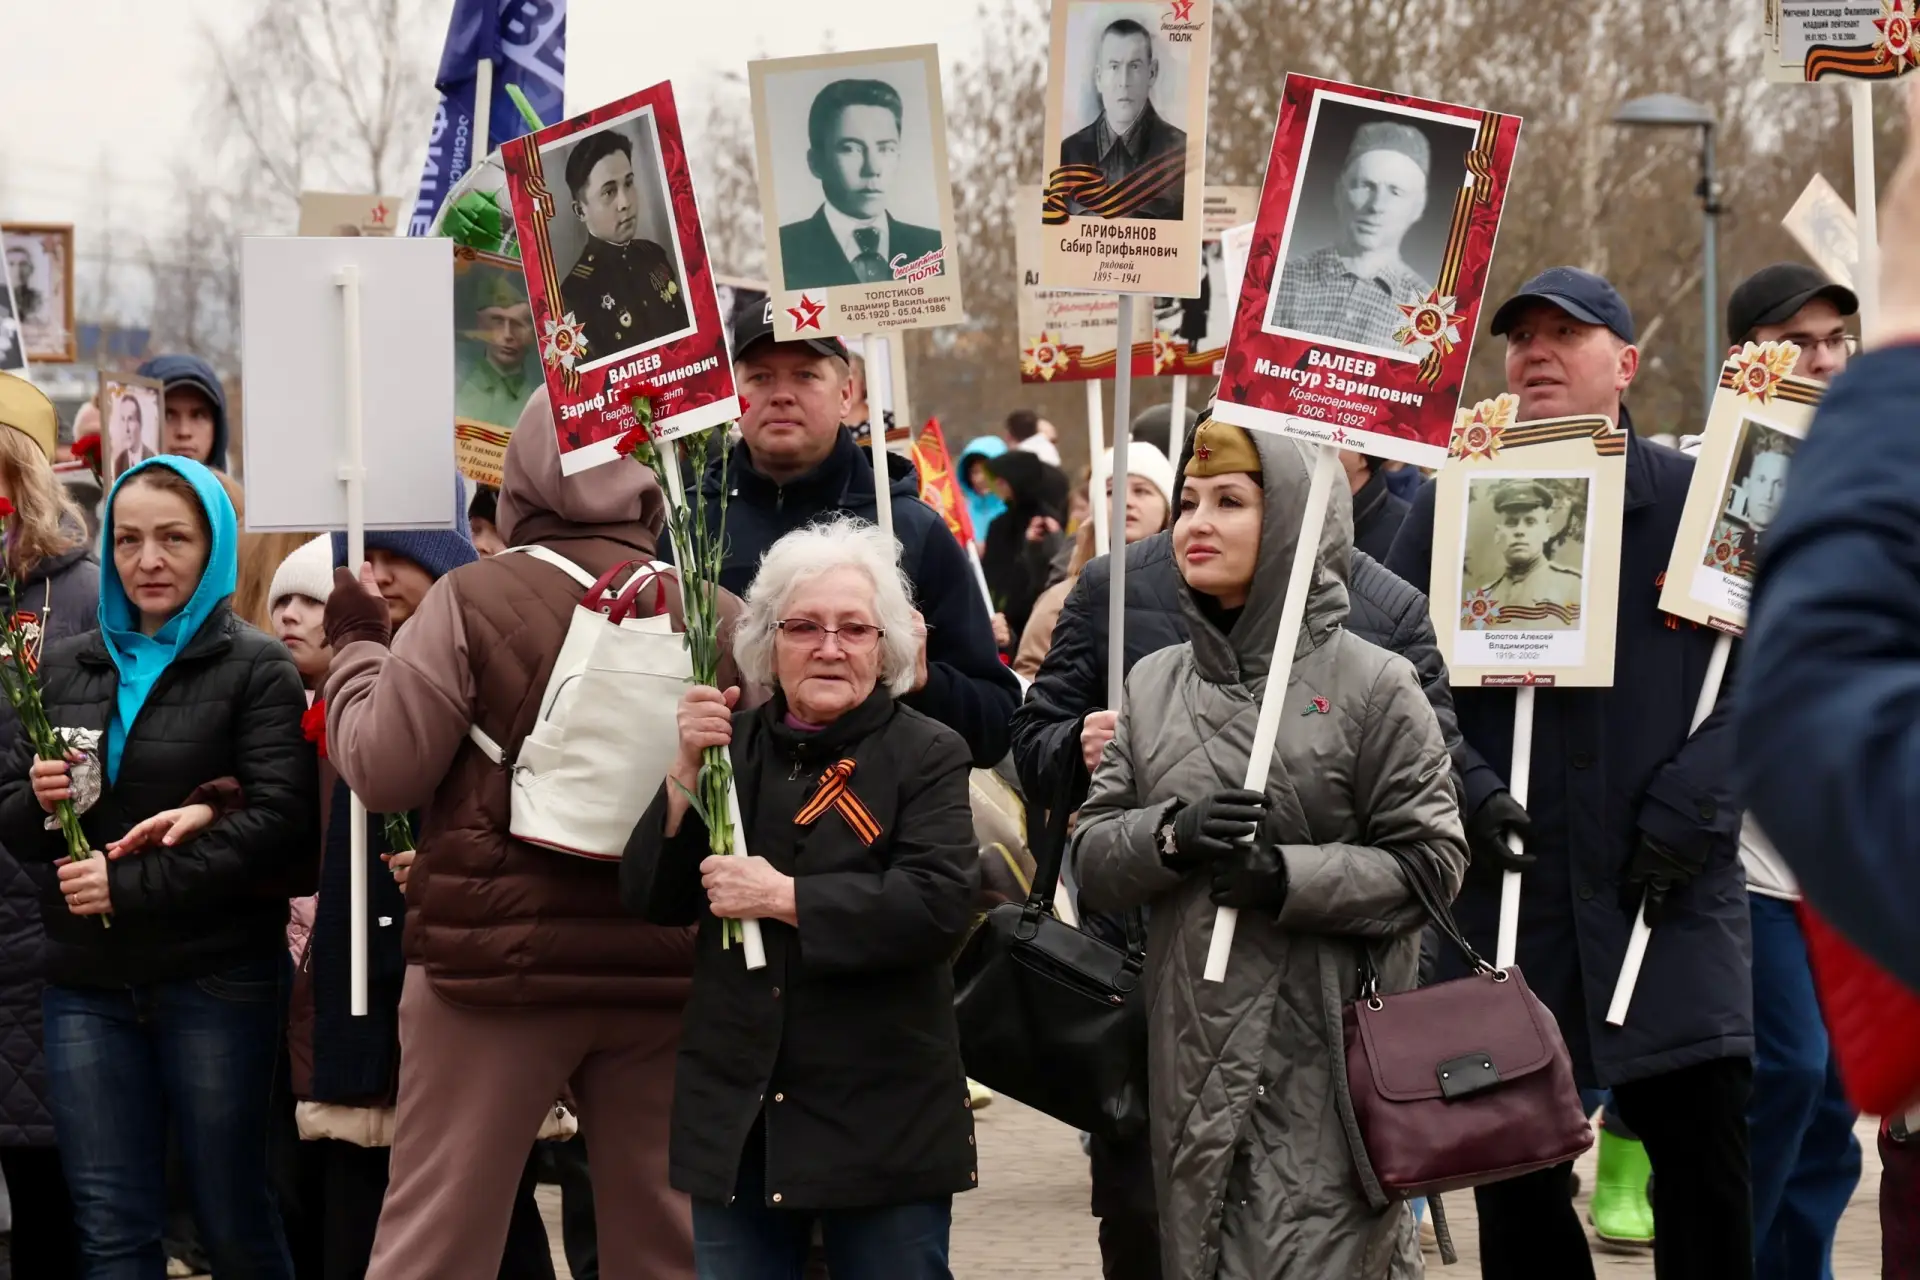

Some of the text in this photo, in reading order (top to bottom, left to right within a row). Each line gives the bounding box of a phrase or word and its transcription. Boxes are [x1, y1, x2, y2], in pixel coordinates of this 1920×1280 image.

[1812, 8, 1842, 17] Александр
[1844, 7, 1880, 16] Филиппович
[1803, 20, 1860, 29] младший лейтенант
[407, 93, 448, 236] ФИЦЕ
[1081, 224, 1156, 240] ГАРИФЬЯНОВ
[1060, 238, 1178, 258] Сабир Гарифьянович
[908, 263, 940, 283] ПОЛК
[1100, 260, 1134, 271] рядовой
[1093, 271, 1112, 282] 1895
[1121, 273, 1141, 284] 1941
[865, 287, 924, 300] ТОЛСТИКОВ
[840, 296, 951, 313] Владимир Васильевич
[846, 309, 890, 321] 4.05.1920
[898, 304, 946, 317] 05.04.1986
[878, 317, 917, 328] старшина
[608, 353, 662, 384] ВАЛЕЕВ
[1307, 349, 1376, 378] ВАЛЕЕВ
[1253, 358, 1322, 388] Мансур
[1324, 373, 1424, 408] Зарипович
[560, 390, 605, 421] Зариф
[1289, 386, 1378, 416] Красноармеец
[1296, 404, 1325, 420] 1906
[1335, 411, 1366, 428] 1992
[1485, 632, 1553, 640] Болотов Алексей
[1488, 641, 1549, 650] Владимирович
